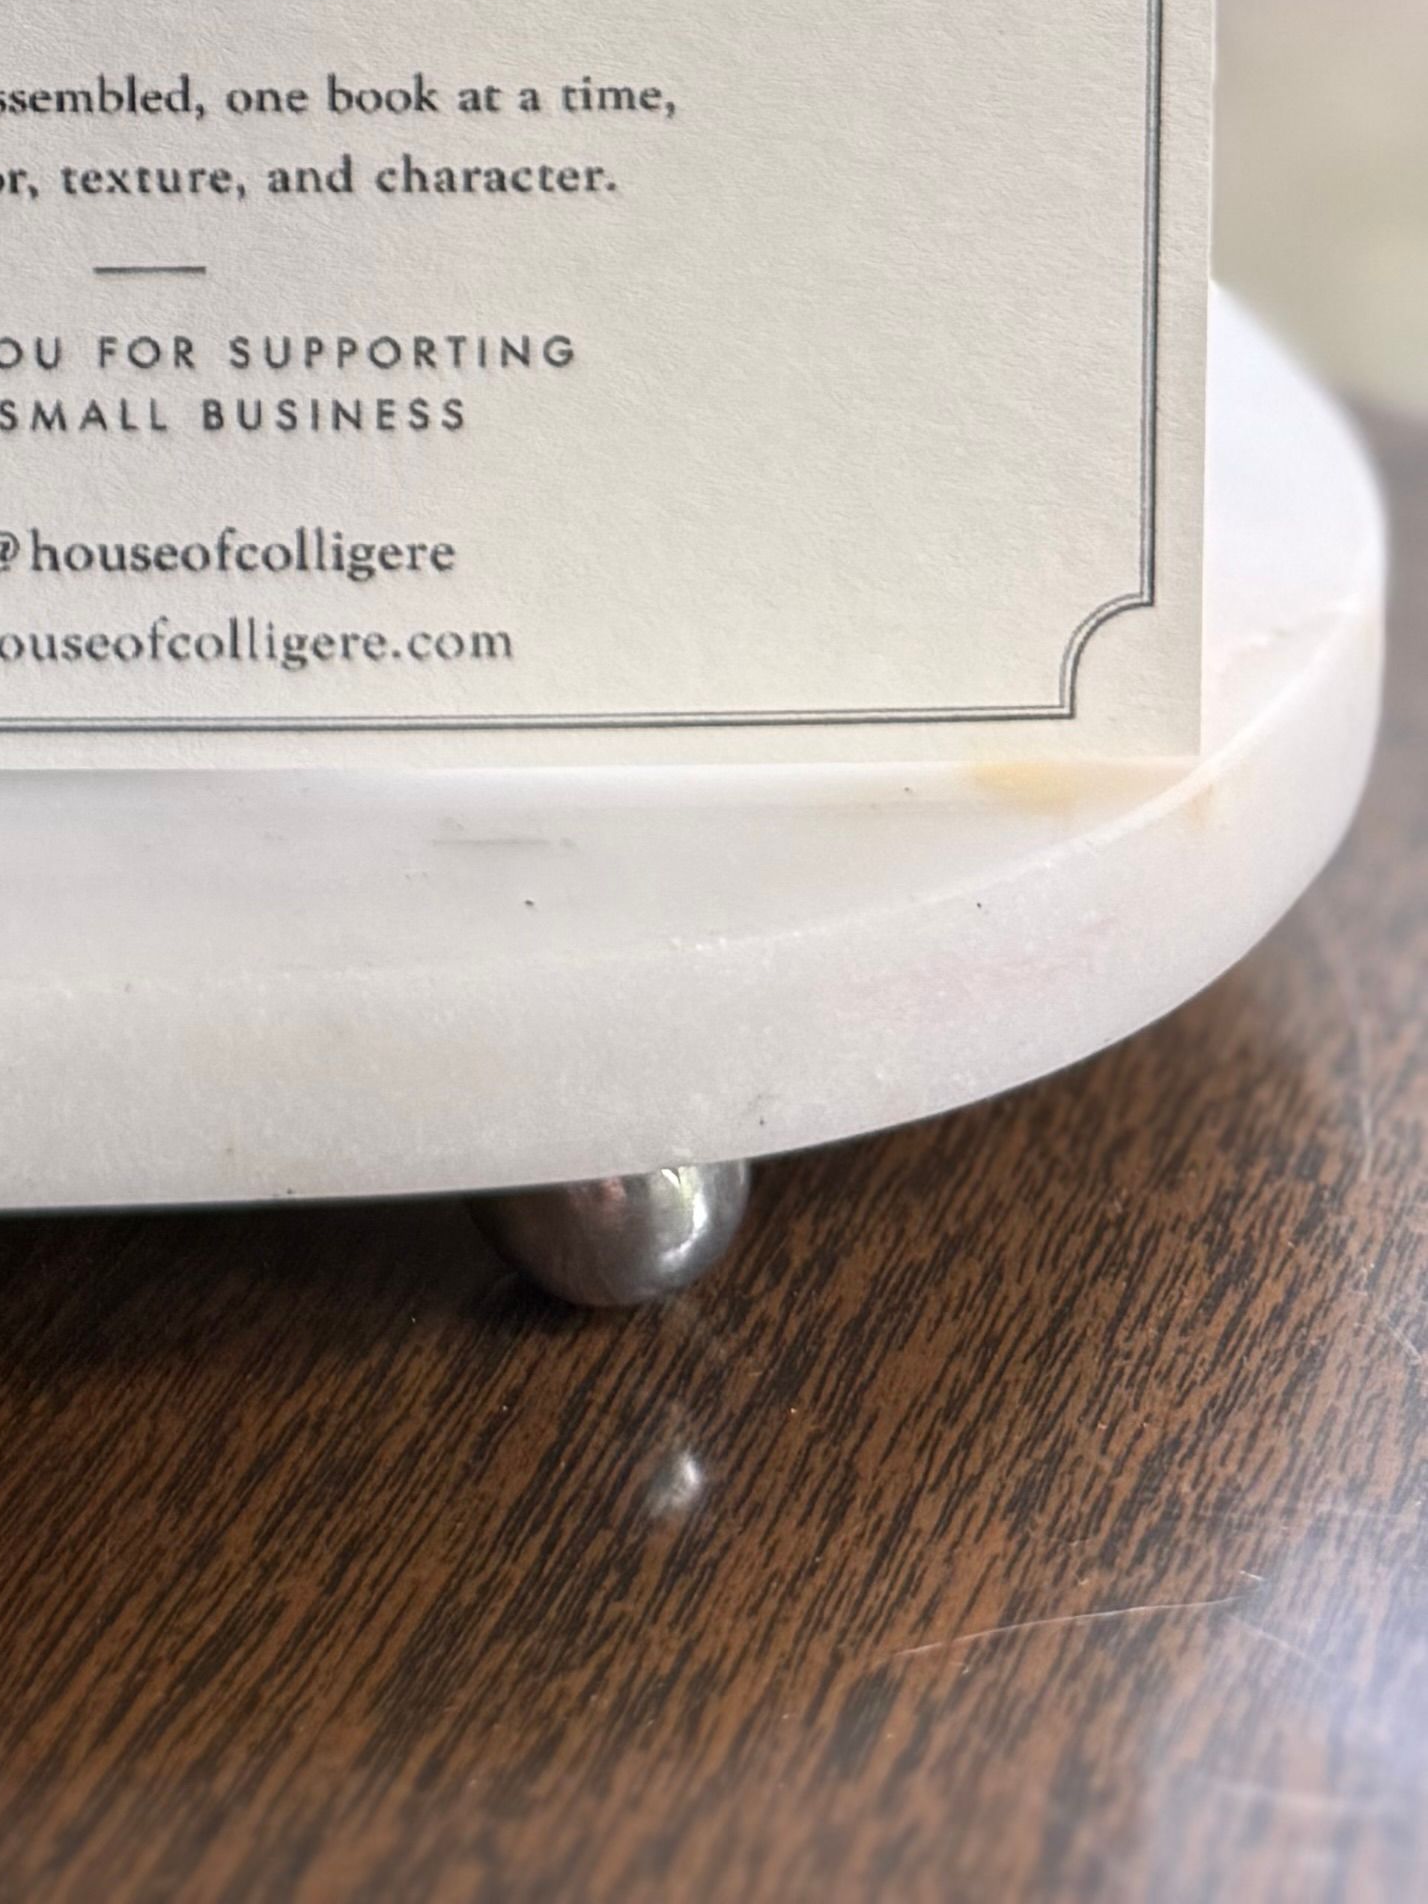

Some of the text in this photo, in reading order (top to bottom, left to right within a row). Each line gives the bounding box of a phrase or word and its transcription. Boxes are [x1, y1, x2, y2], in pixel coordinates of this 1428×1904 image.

[225, 87, 310, 116] one
[326, 71, 440, 116] book
[457, 84, 503, 114] at
[518, 87, 542, 113] a
[561, 75, 677, 120] time,
[60, 162, 247, 203] texture,
[267, 153, 355, 196] and
[374, 152, 618, 196] character.
[97, 335, 196, 371] FOR
[228, 334, 576, 372] SUPPORTING
[201, 396, 465, 434] BUSINESS
